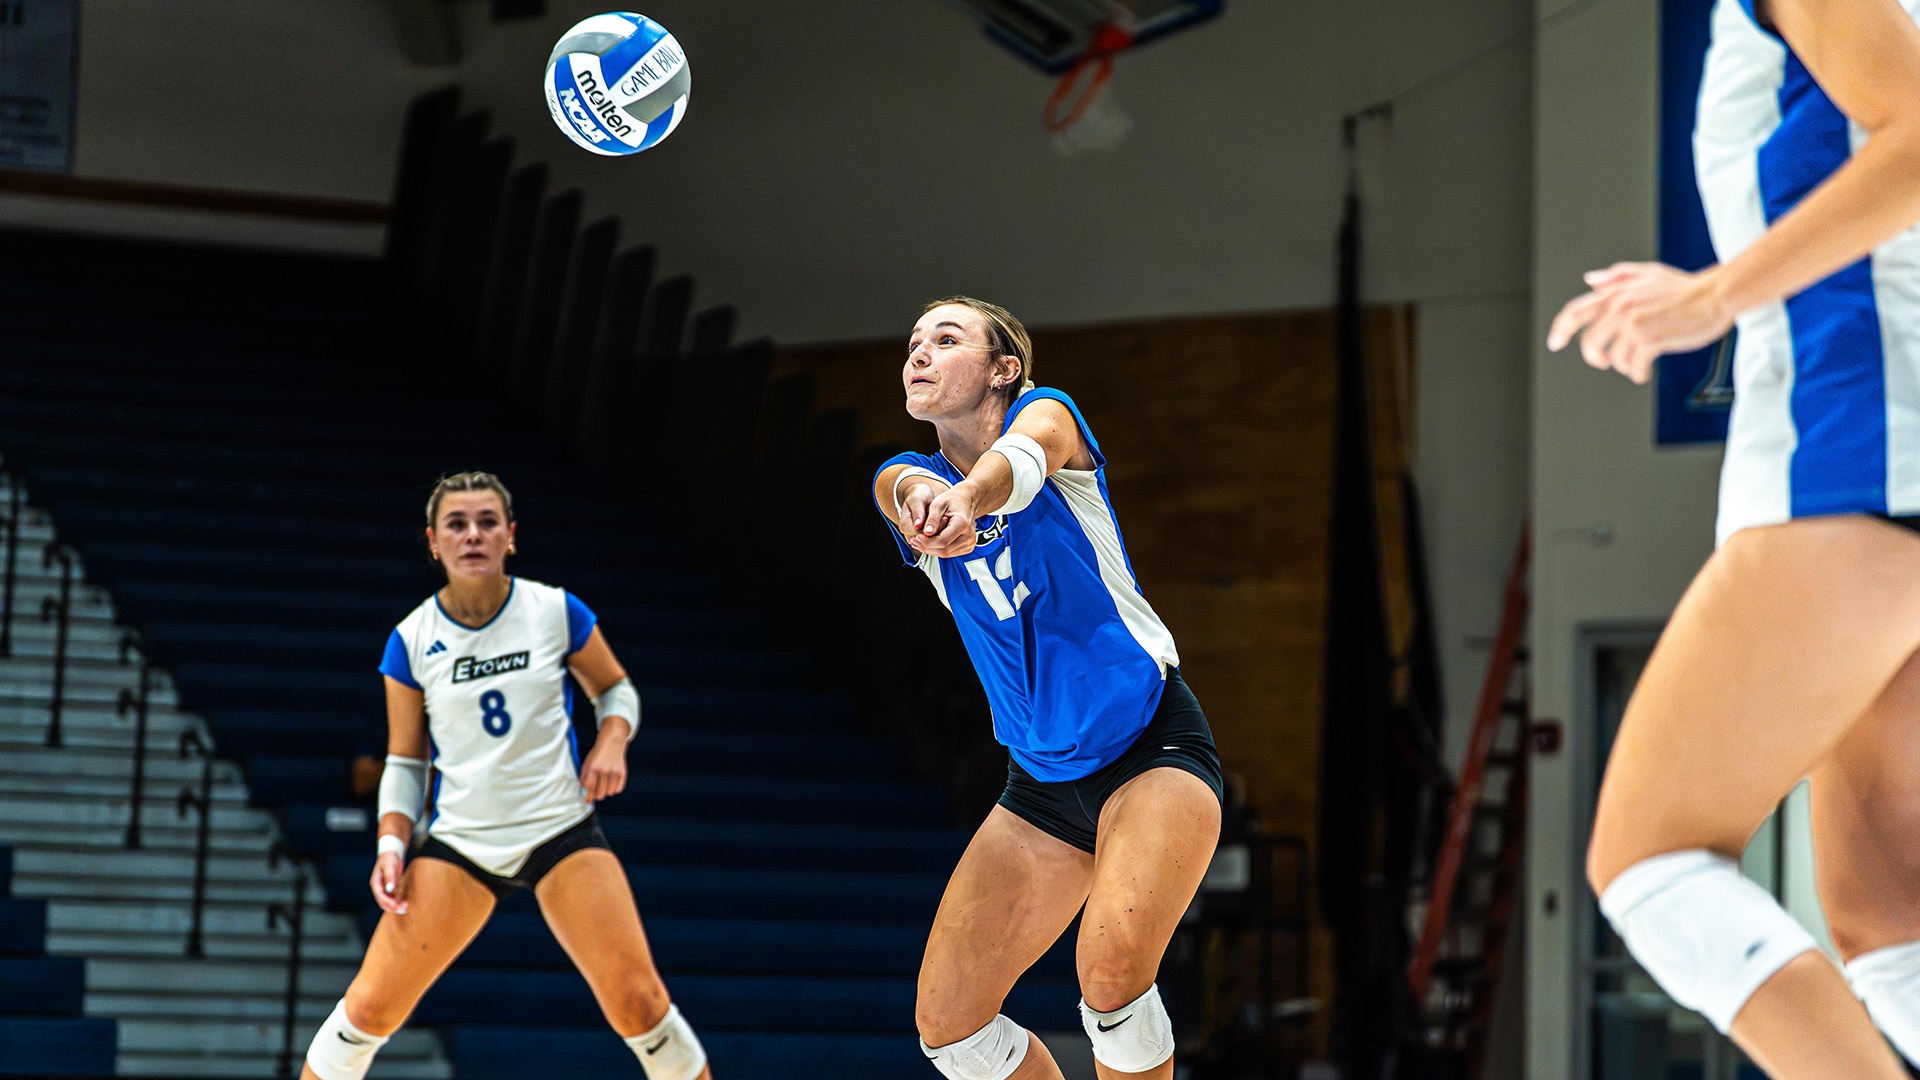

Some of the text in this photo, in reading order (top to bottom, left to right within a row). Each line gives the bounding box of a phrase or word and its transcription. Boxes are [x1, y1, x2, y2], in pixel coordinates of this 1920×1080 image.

[577, 69, 632, 137] molten
[621, 60, 661, 96] GAME
[559, 87, 609, 144] NCAA
[479, 689, 512, 737] 8
